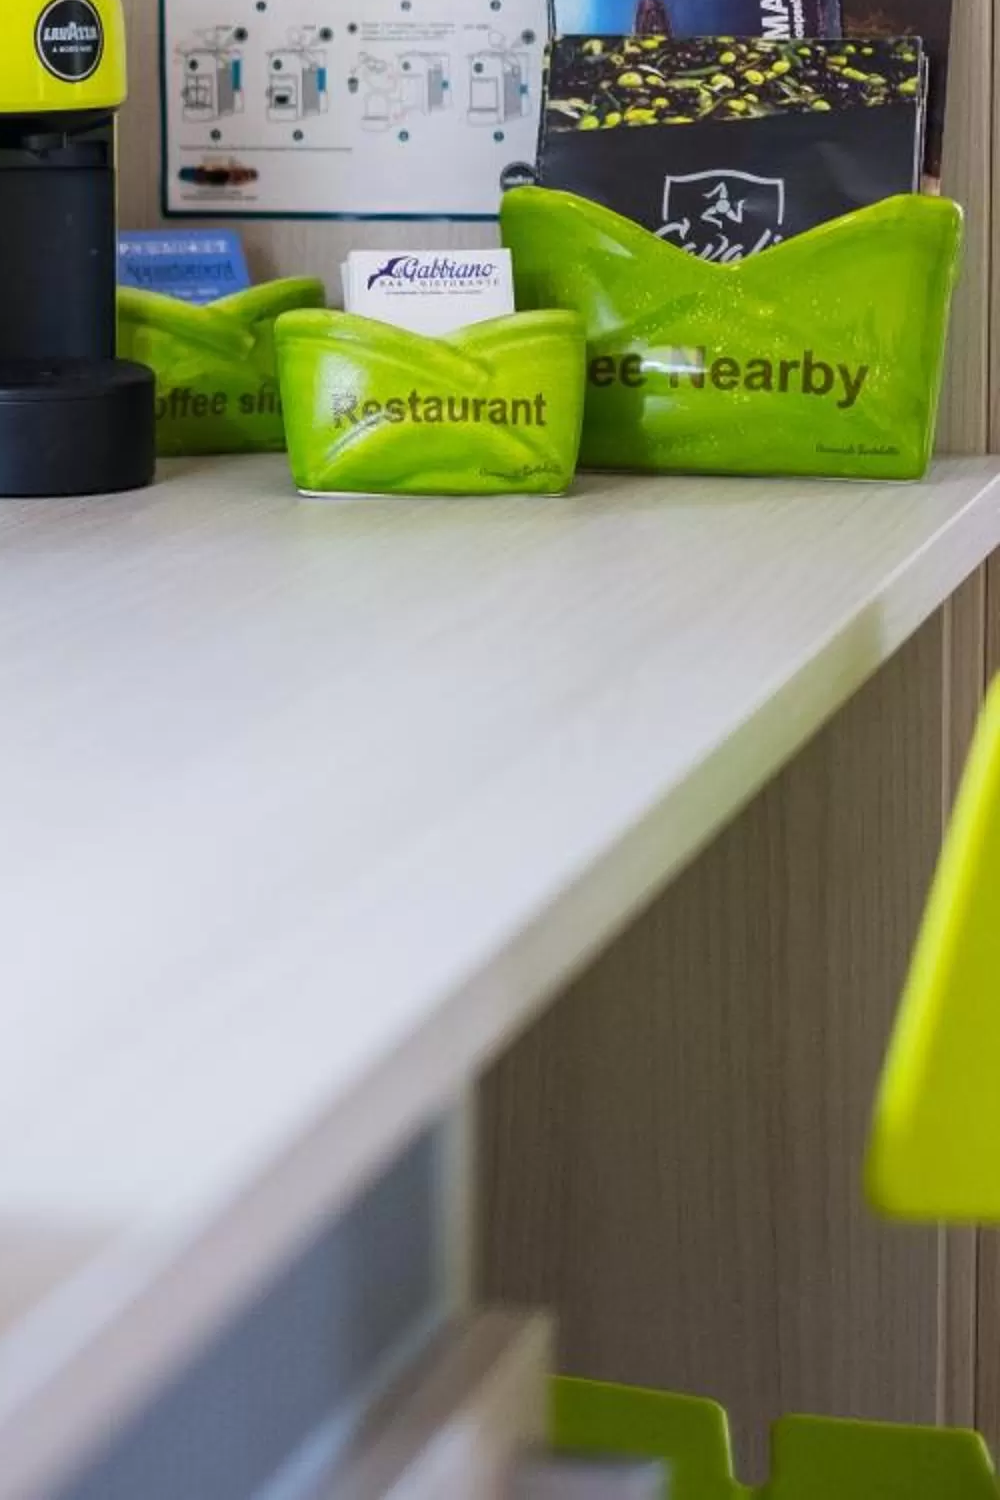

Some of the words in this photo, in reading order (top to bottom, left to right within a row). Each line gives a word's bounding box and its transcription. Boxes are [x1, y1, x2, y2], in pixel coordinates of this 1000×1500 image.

[43, 21, 98, 41] LAVAZZA
[402, 256, 499, 282] Gabbiano
[588, 352, 647, 388] ee
[669, 346, 869, 409] Nearby
[154, 386, 228, 420] offee
[331, 388, 548, 428] Restaurant
